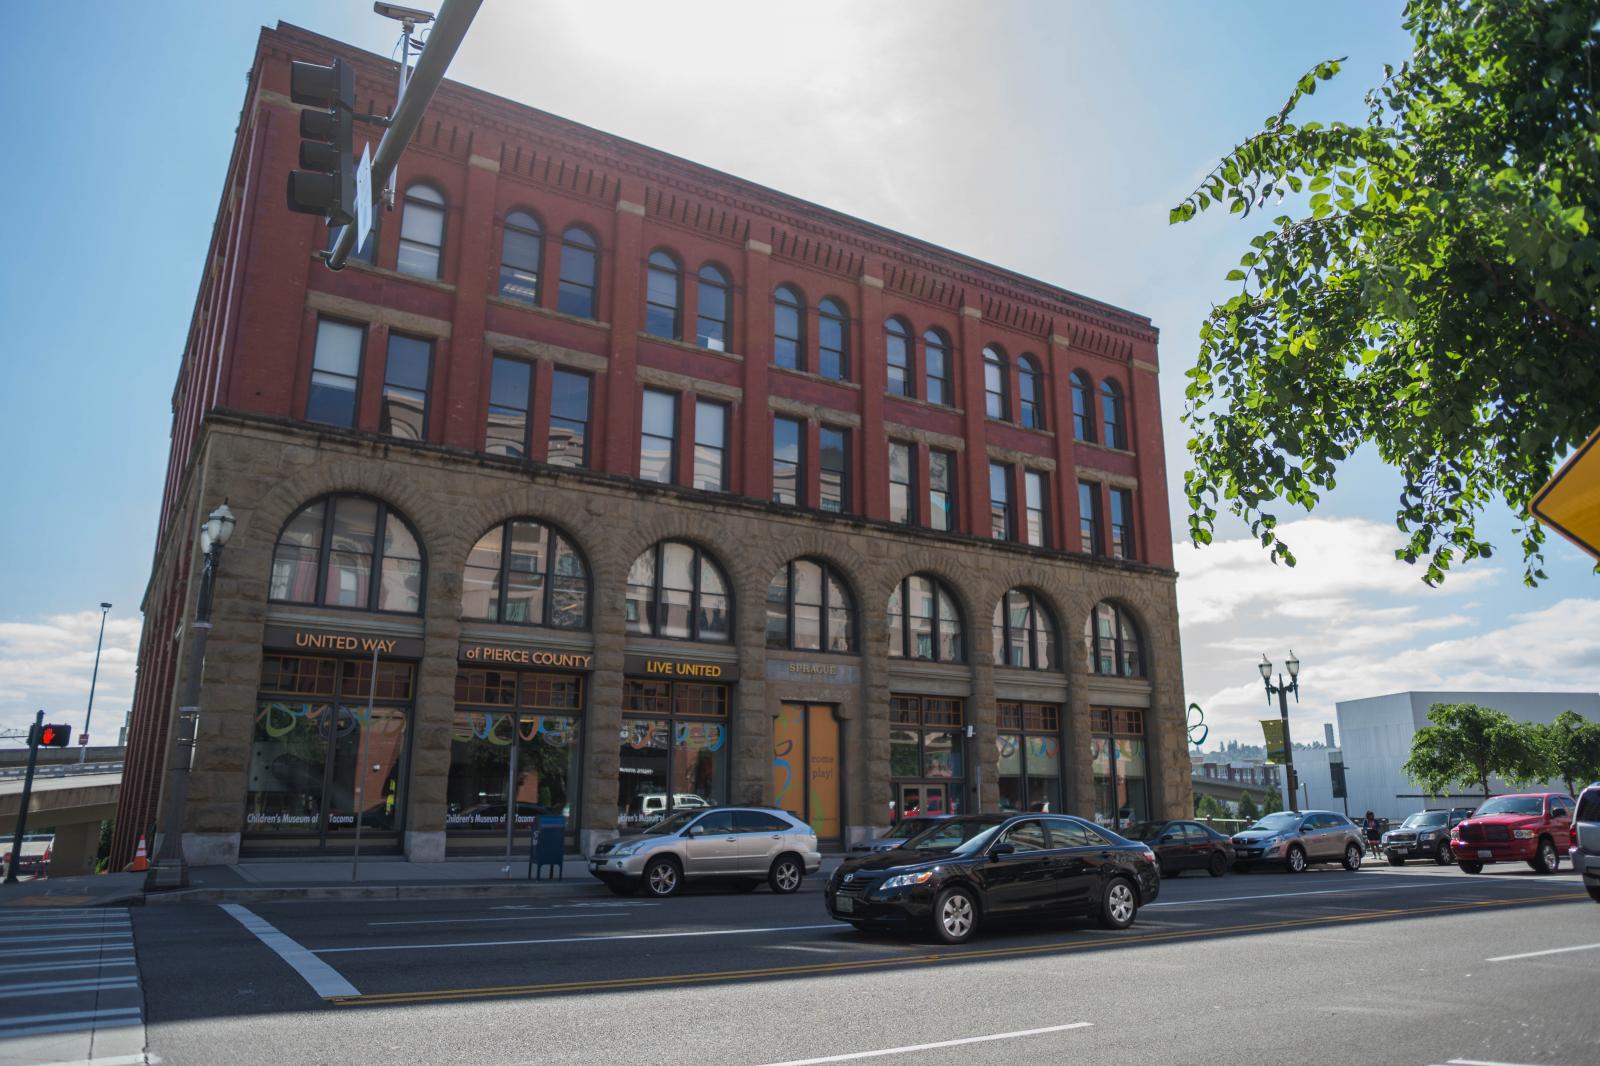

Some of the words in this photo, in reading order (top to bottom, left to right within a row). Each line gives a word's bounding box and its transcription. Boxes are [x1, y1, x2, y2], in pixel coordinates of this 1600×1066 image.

[296, 633, 358, 650] UNITED
[361, 638, 397, 653] WAY
[466, 647, 481, 659] of
[483, 647, 530, 663] PIERCE
[532, 651, 591, 668] COUNTY
[647, 661, 673, 674] LIVE
[676, 663, 721, 677] UNITED
[247, 813, 281, 824] Children's
[282, 813, 311, 824] Museum
[311, 813, 320, 824] of
[328, 813, 354, 824] Tacoma
[474, 813, 499, 824] Museum
[499, 813, 506, 823] of
[514, 814, 536, 823] Tacom
